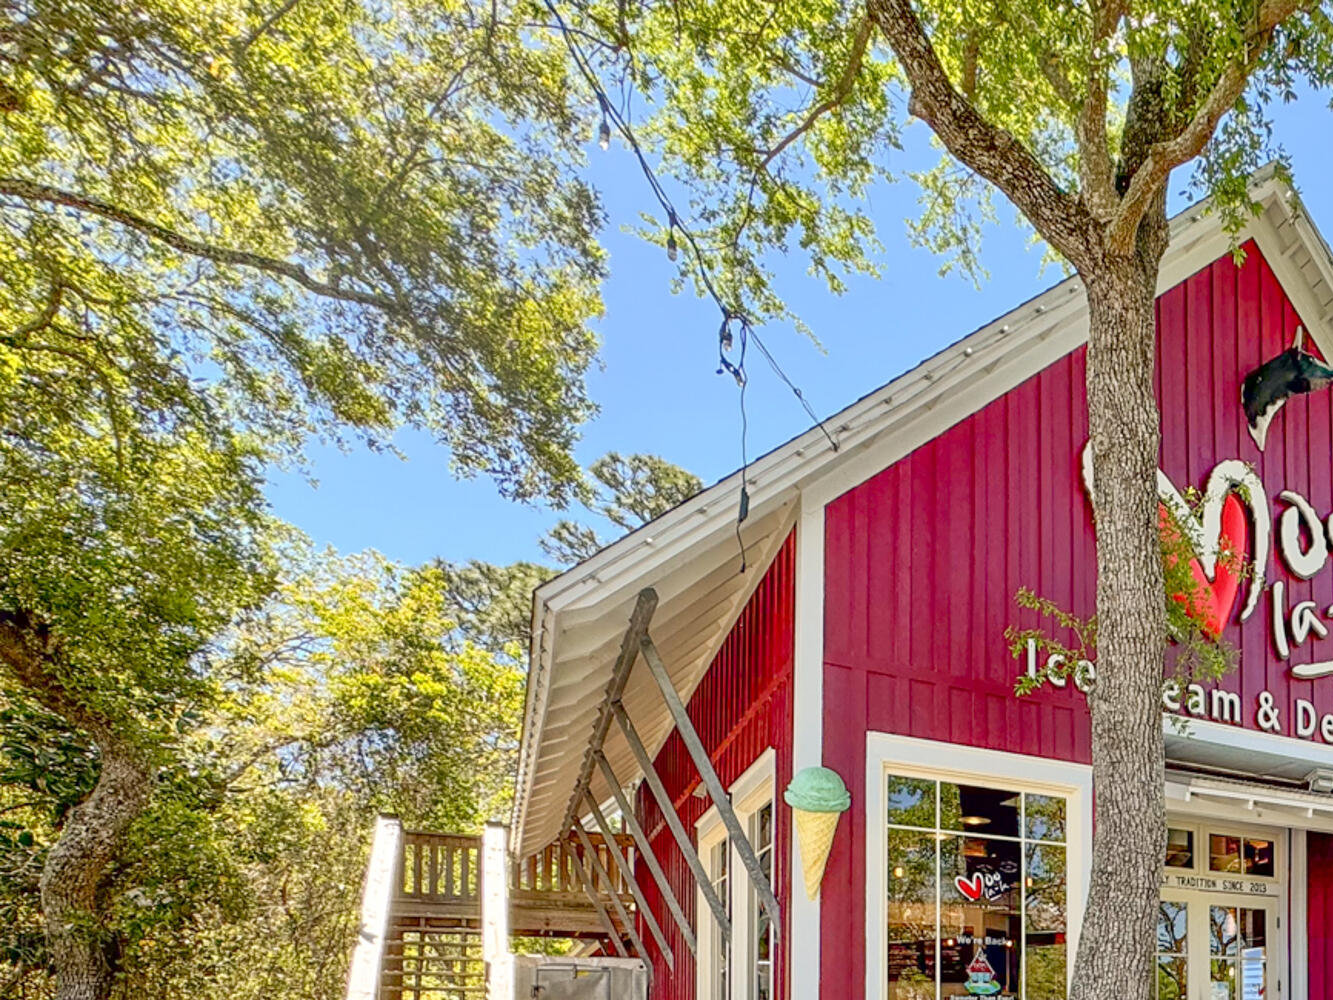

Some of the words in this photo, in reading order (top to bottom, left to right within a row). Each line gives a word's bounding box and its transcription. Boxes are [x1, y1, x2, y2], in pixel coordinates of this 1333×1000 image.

[1027, 638, 1097, 693] Ice
[1162, 678, 1242, 724] eam
[1257, 690, 1282, 734] &
[1176, 876, 1217, 889] TRADITION
[1222, 880, 1245, 892] SINCE
[1249, 882, 1268, 894] 2013
